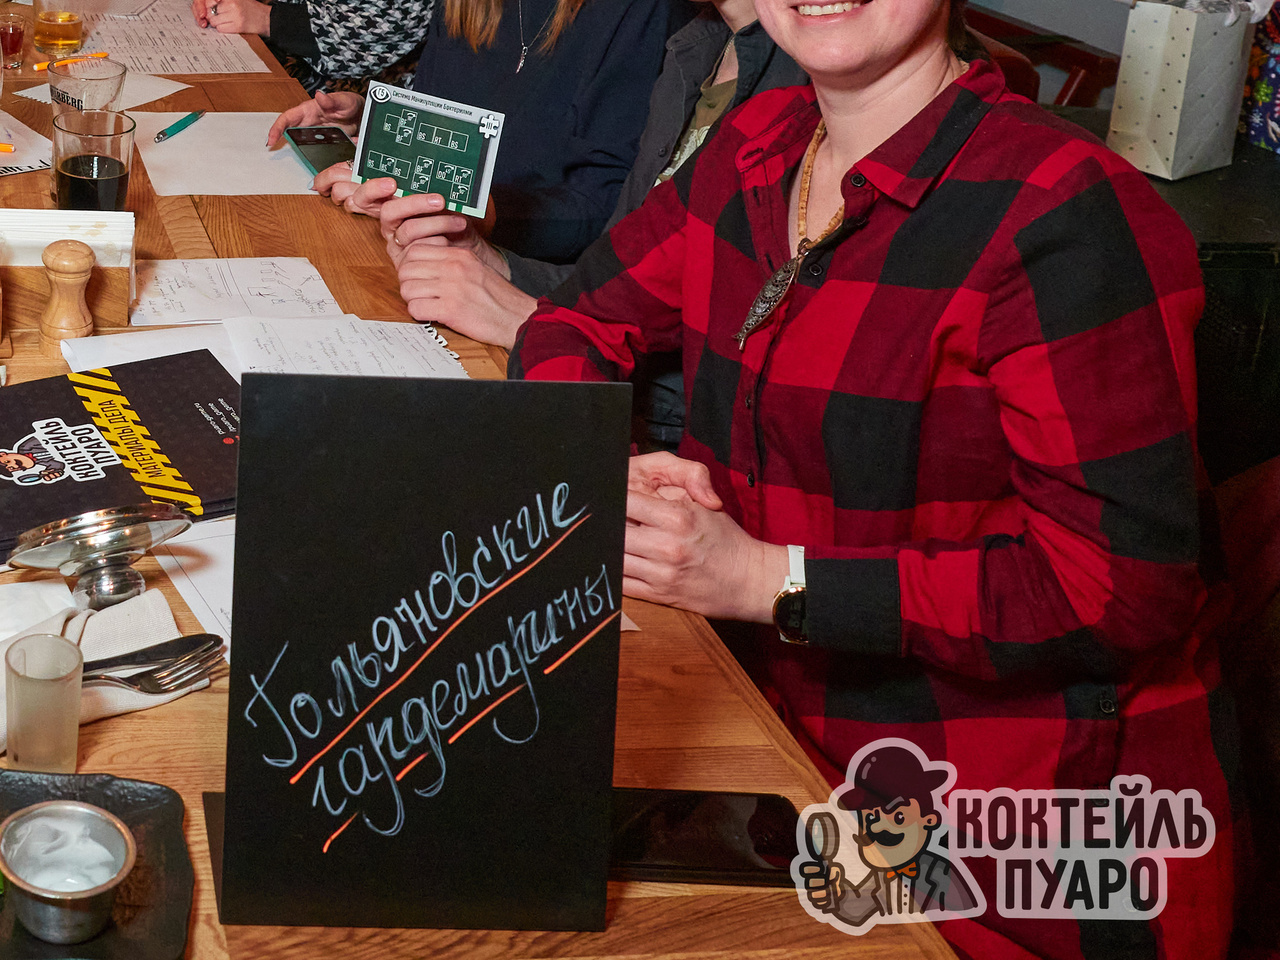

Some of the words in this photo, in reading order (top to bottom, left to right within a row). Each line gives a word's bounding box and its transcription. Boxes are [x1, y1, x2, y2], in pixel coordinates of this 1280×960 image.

[98, 399, 131, 424] ДЕЛА
[39, 421, 101, 479] КОКТЕЙЛЬ
[71, 427, 117, 464] ПУАРО
[113, 425, 166, 478] МАТЕРИАЛЫ
[244, 482, 588, 767] Гольяновские
